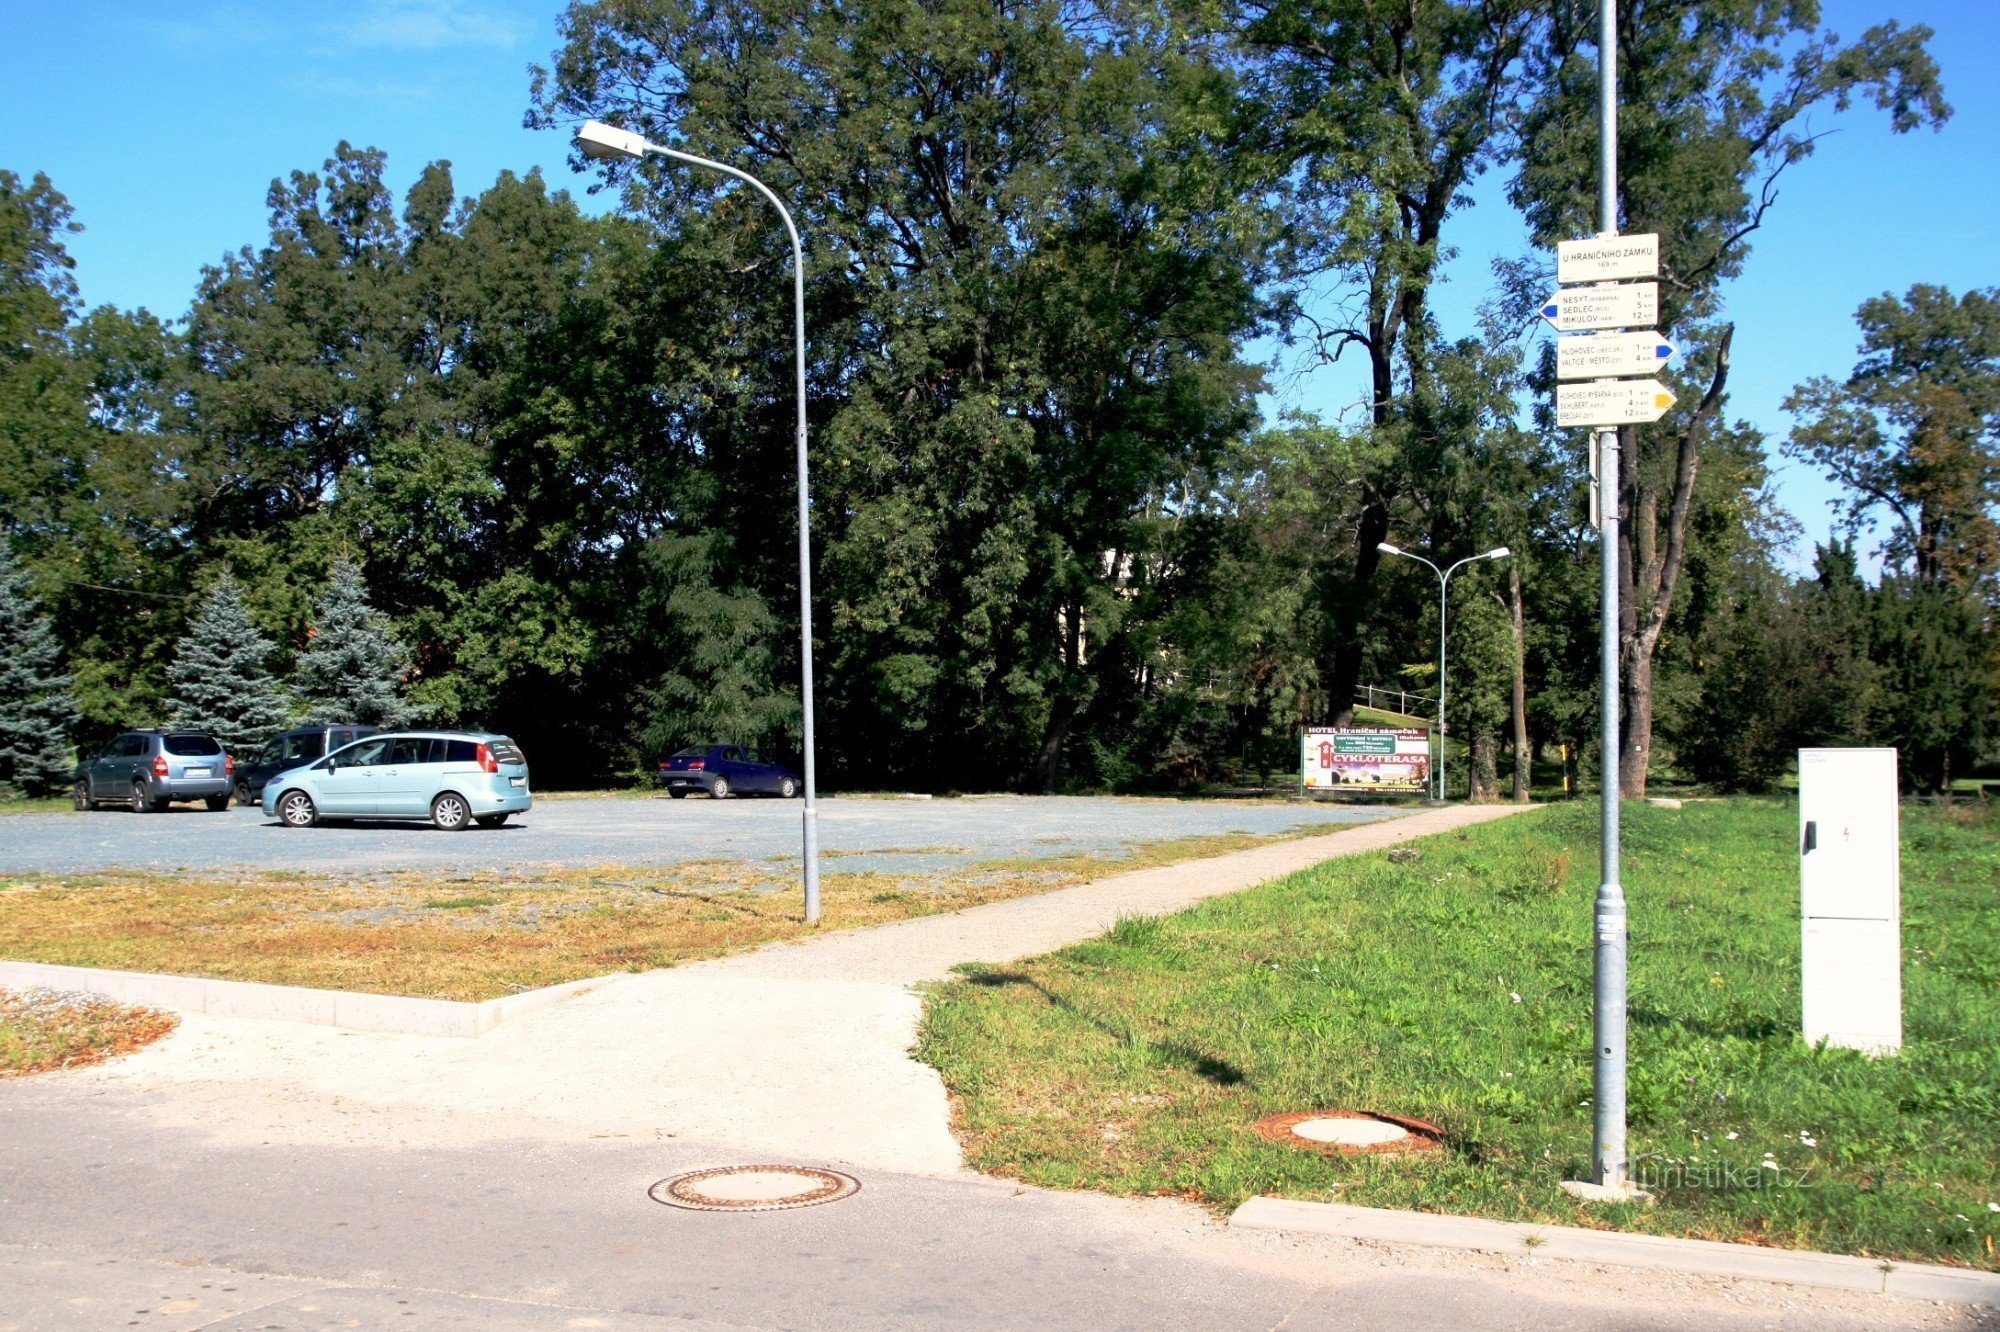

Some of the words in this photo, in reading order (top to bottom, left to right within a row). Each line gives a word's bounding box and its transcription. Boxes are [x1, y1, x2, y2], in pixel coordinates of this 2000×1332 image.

[1563, 295, 1588, 304] NESYT
[1563, 305, 1593, 314] SEDLEC
[1637, 301, 1642, 309] 5
[1563, 315, 1598, 323] MIKULOV
[1333, 754, 1426, 763] CYKLOTERASA
